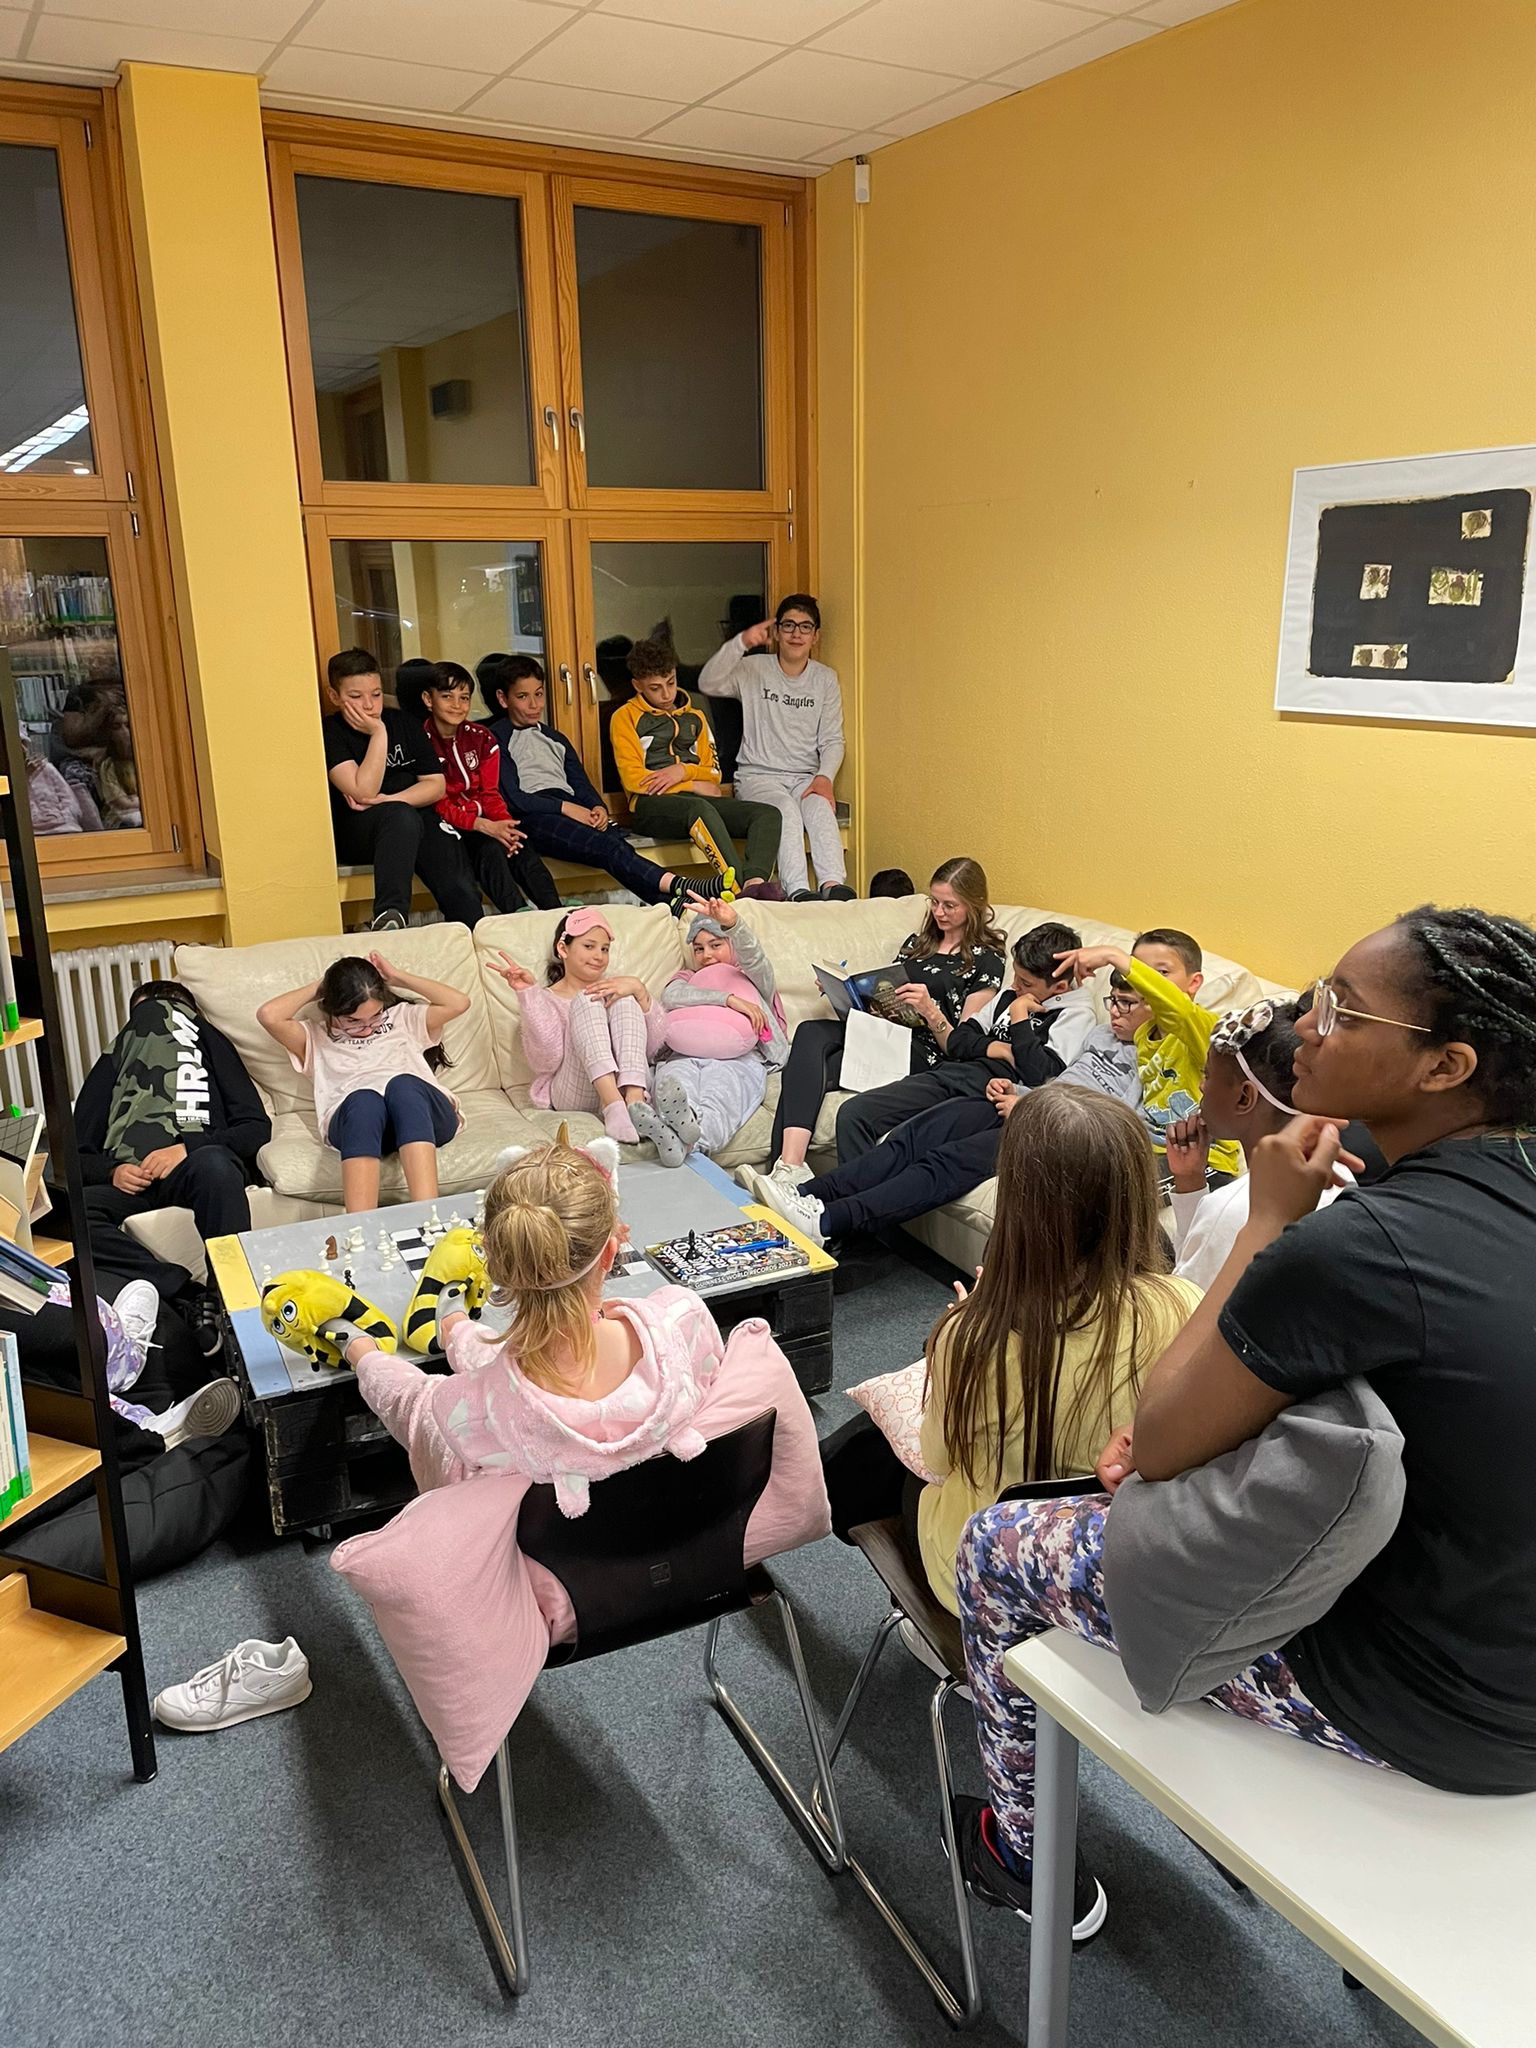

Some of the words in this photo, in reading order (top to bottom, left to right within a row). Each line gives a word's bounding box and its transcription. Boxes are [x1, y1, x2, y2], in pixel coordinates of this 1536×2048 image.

[761, 688, 779, 702] Los
[782, 694, 815, 708] Angeles
[702, 1234, 758, 1266] 223
[726, 1270, 749, 1281] WORLD
[750, 1264, 777, 1276] RECORDS
[778, 1260, 792, 1269] 2023
